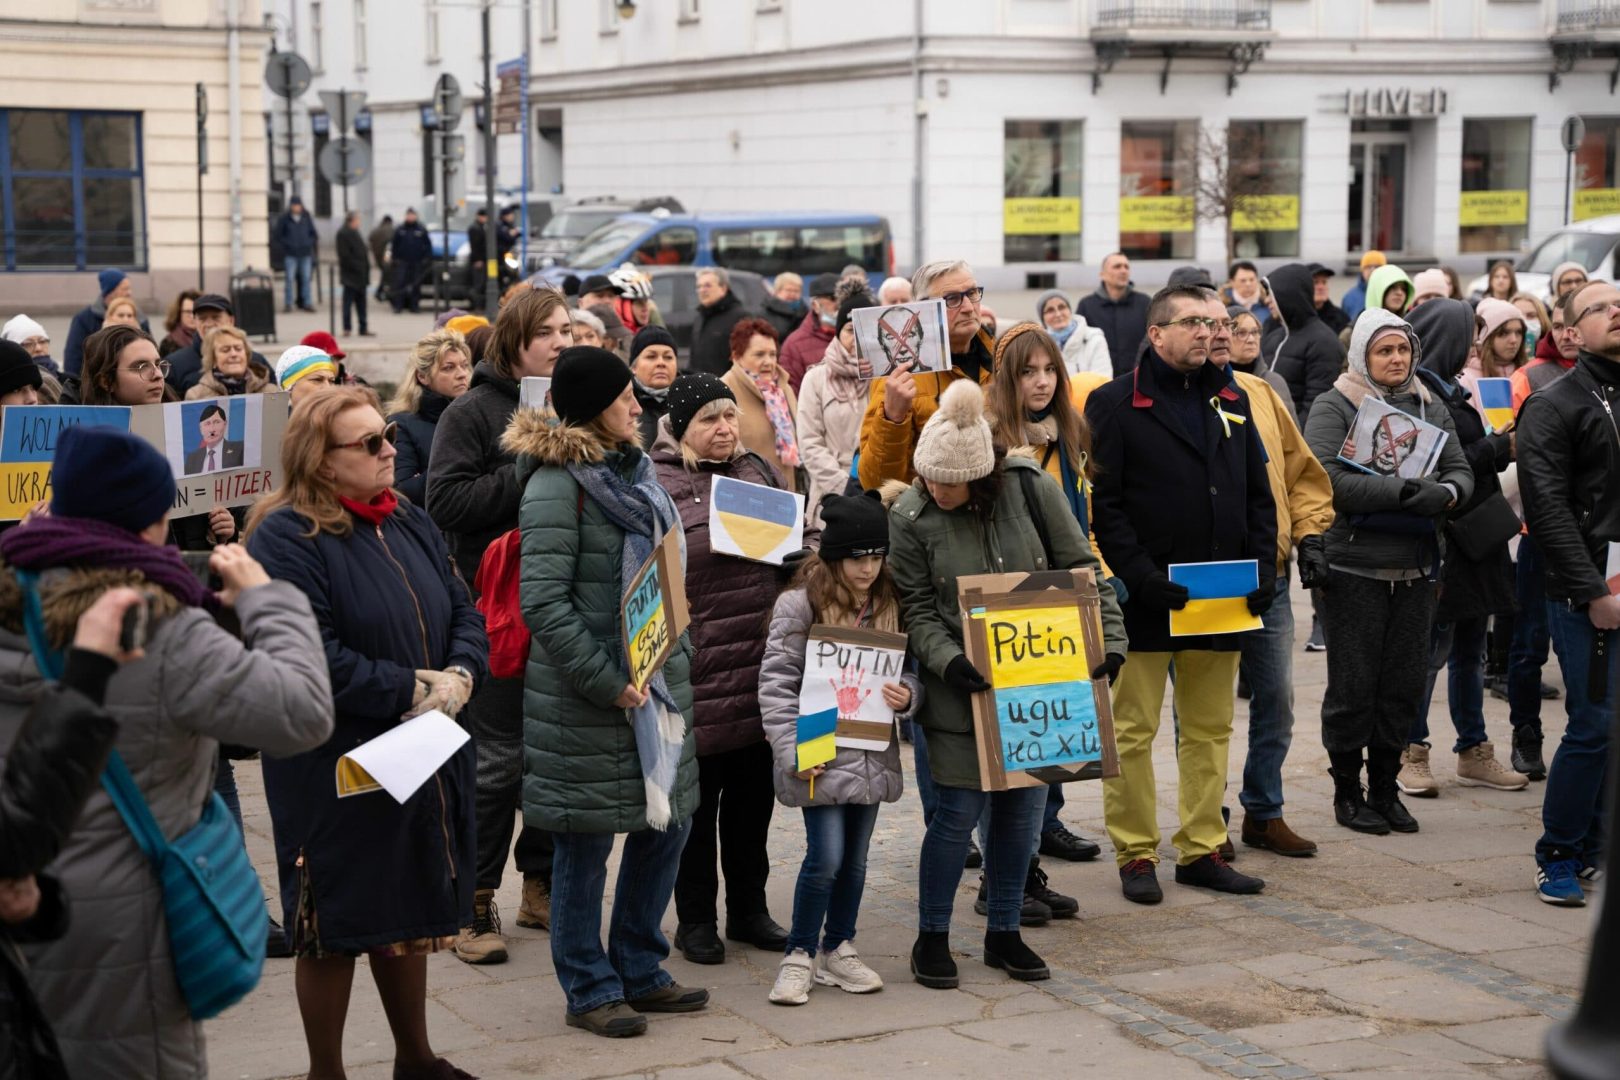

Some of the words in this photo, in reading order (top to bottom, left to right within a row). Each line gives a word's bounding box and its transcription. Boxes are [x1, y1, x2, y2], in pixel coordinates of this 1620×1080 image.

[20, 416, 80, 453] WOL
[214, 470, 272, 502] HITLER
[634, 622, 668, 683] HOME
[637, 620, 656, 652] GO
[990, 621, 1077, 665] Putin
[816, 641, 905, 678] PUTIN
[1007, 741, 1048, 763] на
